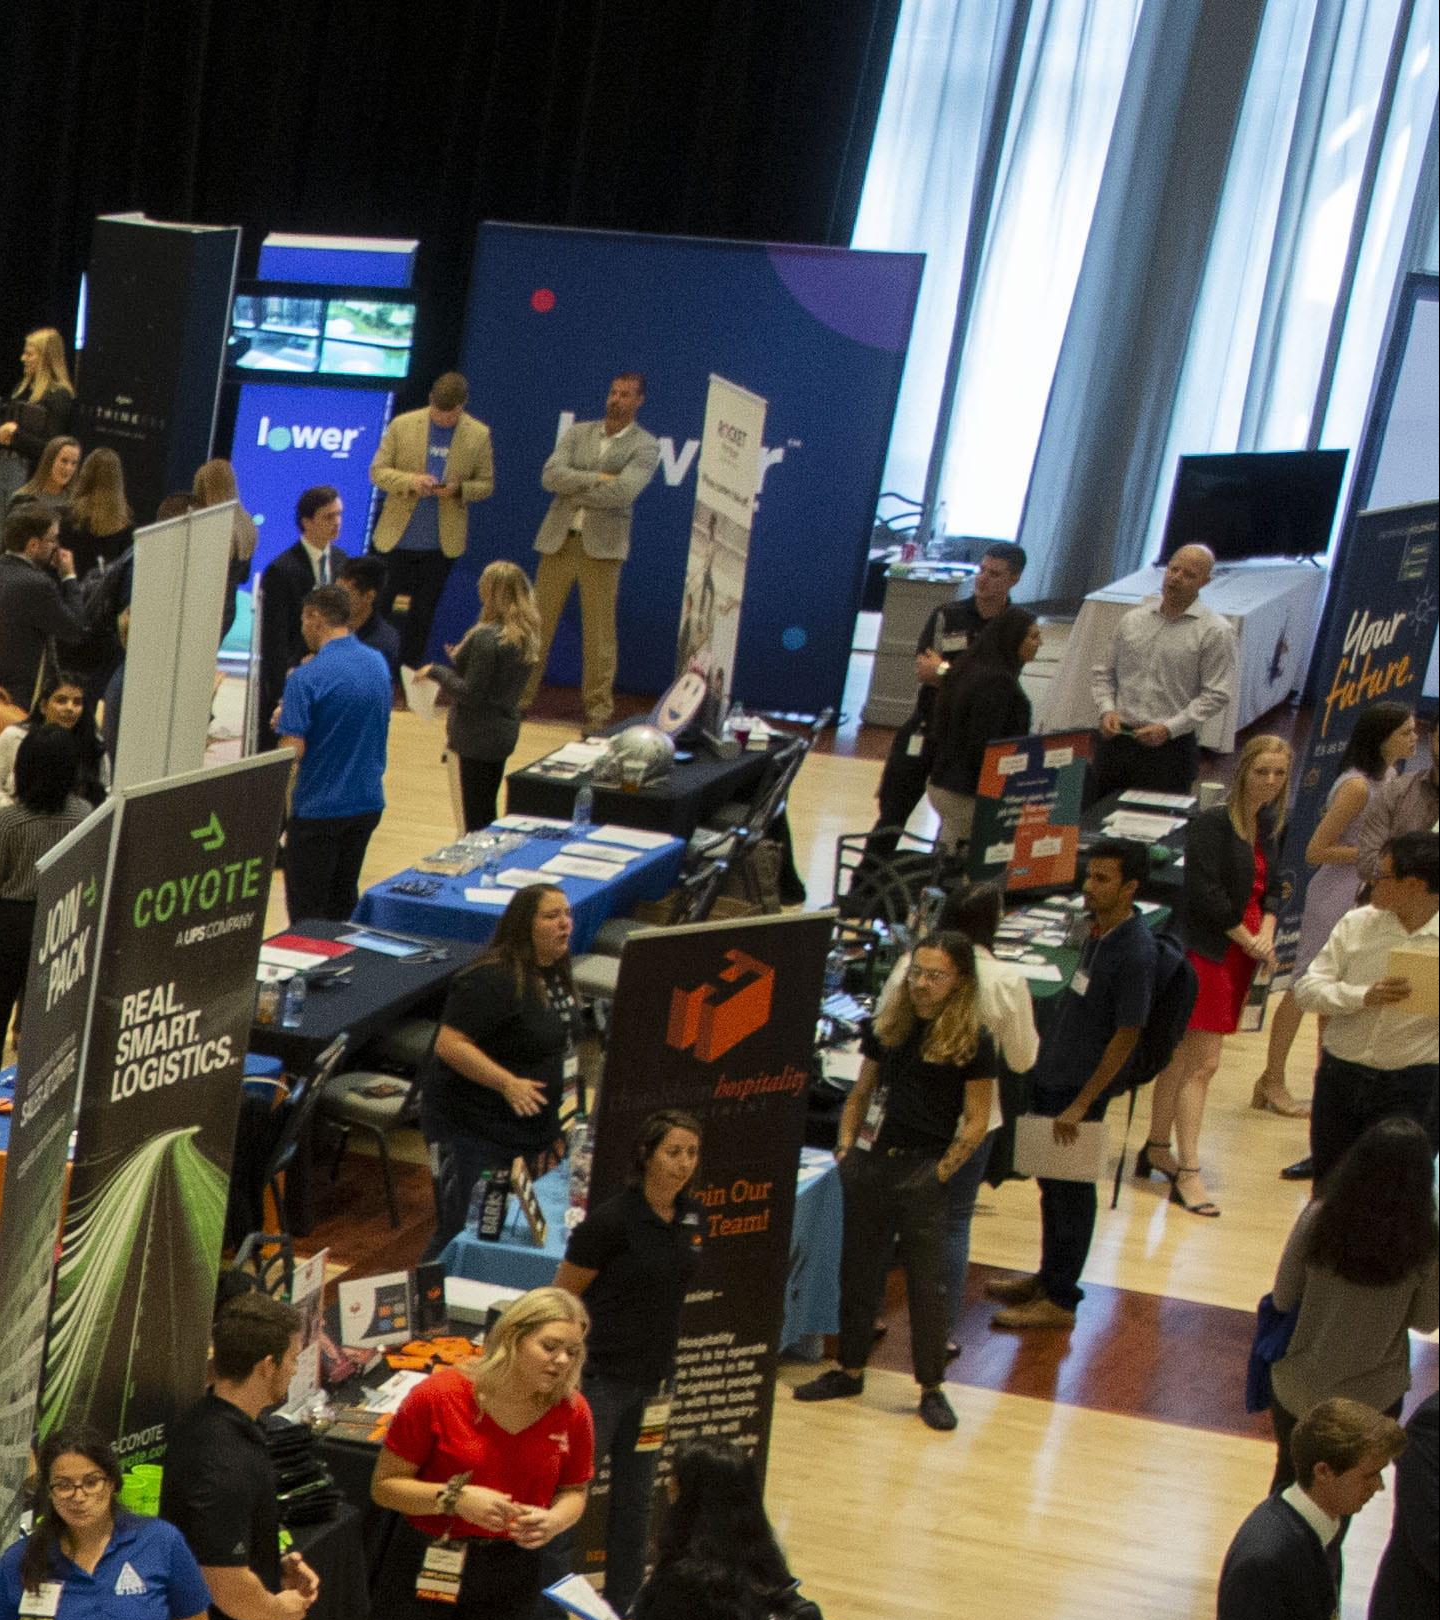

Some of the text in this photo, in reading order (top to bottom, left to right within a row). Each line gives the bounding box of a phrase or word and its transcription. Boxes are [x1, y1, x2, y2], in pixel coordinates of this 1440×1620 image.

[258, 416, 357, 450] lower
[1343, 608, 1406, 672] Your
[1320, 655, 1414, 736] future.
[134, 857, 262, 929] COYOTE
[38, 880, 83, 966] JOIN
[184, 924, 206, 945] UPS
[206, 912, 256, 941] COMPANY
[47, 928, 90, 1012] PACK
[120, 981, 183, 1030] REAL.
[116, 1008, 200, 1067] SMART.
[111, 1039, 235, 1103] LOGISTICS.
[713, 1064, 808, 1100] hospitality
[732, 1179, 773, 1203] Our
[707, 1209, 770, 1237] Team!
